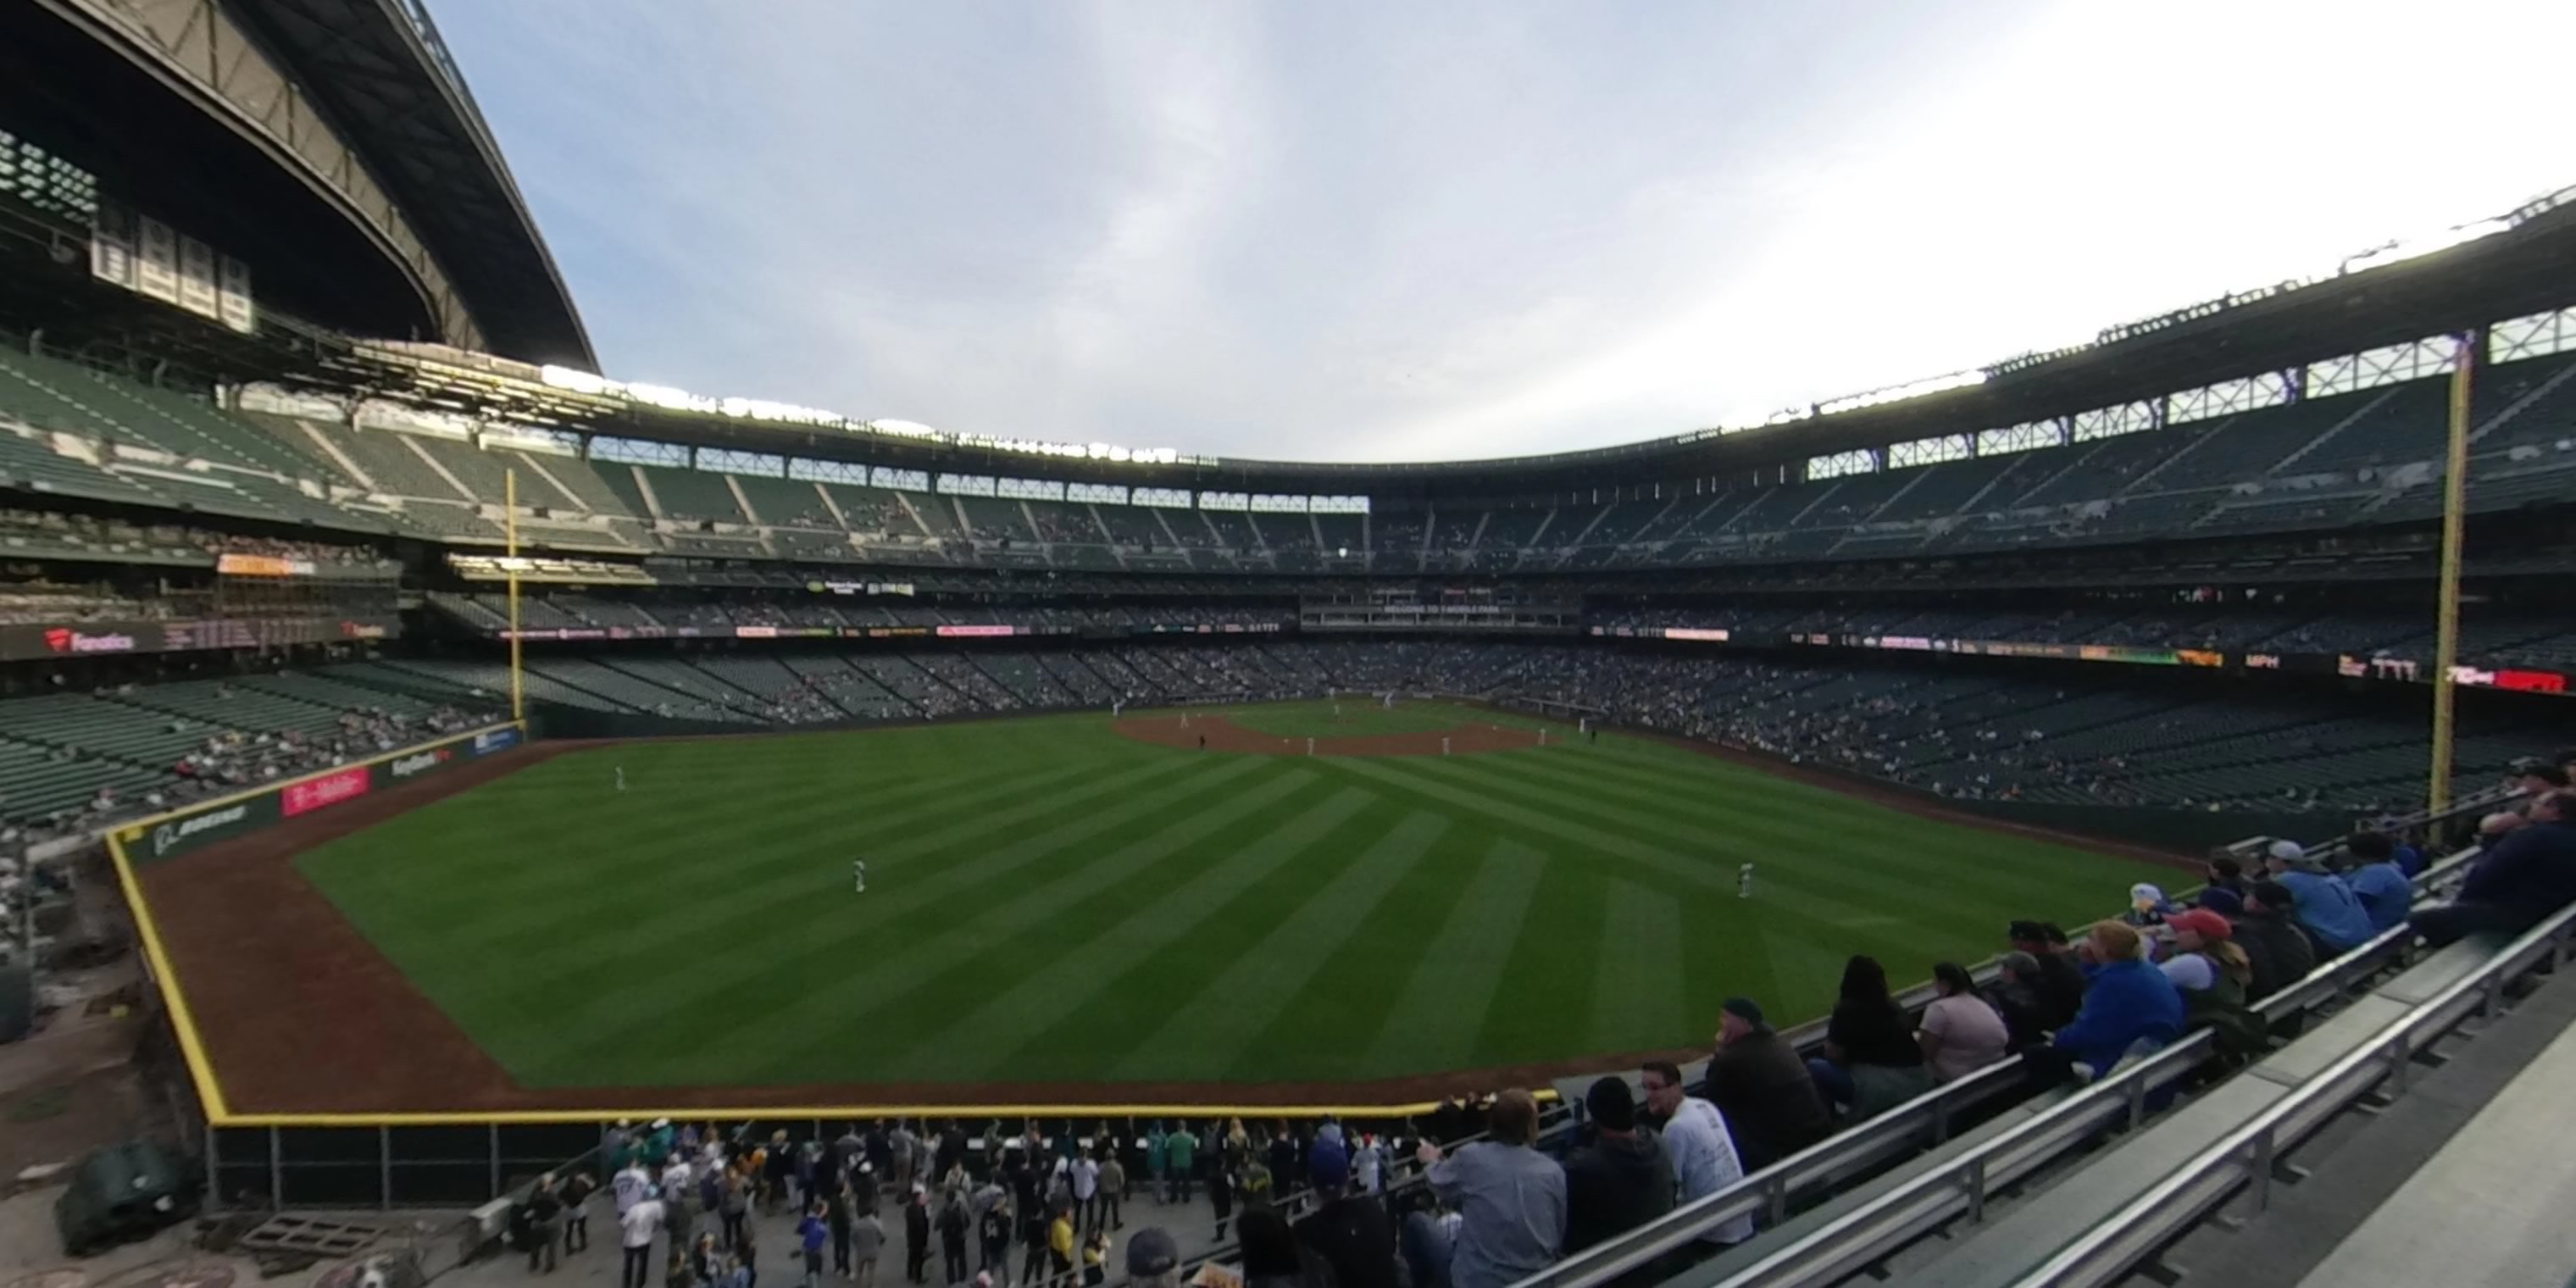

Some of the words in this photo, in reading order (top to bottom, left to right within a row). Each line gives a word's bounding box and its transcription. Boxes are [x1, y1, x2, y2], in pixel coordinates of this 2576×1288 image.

[70, 632, 134, 652] Fanatics
[2246, 654, 2279, 669] MPH
[178, 805, 247, 836] BOEING
